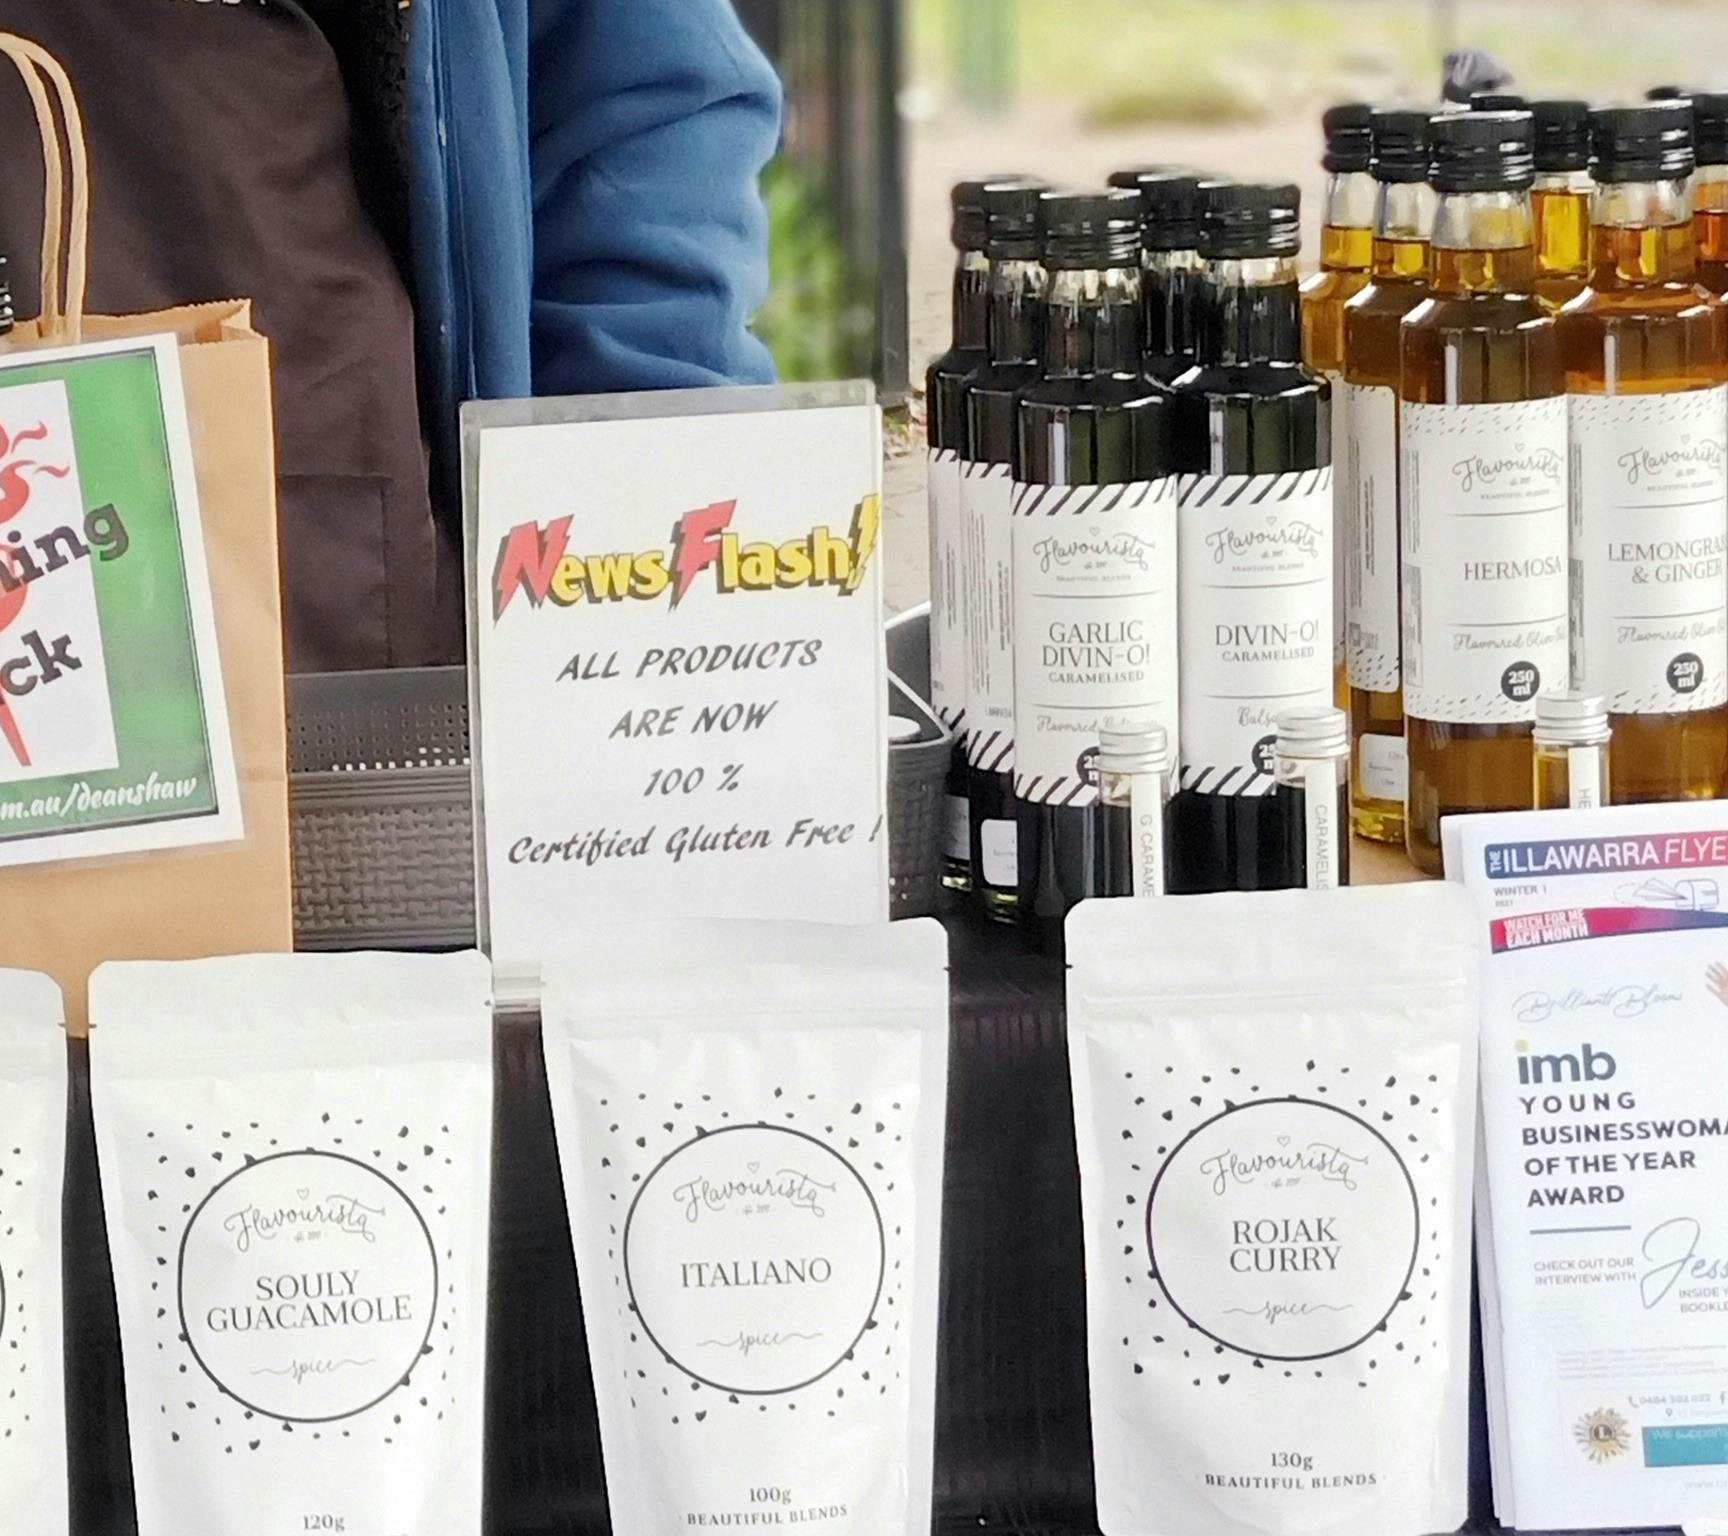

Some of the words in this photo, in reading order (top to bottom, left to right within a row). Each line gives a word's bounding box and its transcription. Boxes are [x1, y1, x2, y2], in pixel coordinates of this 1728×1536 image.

[1033, 530, 1156, 572] Flavourista
[1464, 556, 1562, 582] HERMOSA
[1631, 565, 1649, 585] &
[1655, 557, 1724, 584] GINGER
[1049, 620, 1144, 644] GARLIC
[1215, 619, 1320, 647] DIVIN-O!
[556, 651, 620, 683] ALL
[636, 639, 823, 679] PRODUCTS
[1042, 644, 1150, 668] DIVIN-O!
[1222, 646, 1315, 663] CARAMELISED
[1048, 670, 1145, 684] CARAMELISED
[1508, 669, 1535, 684] 250
[1673, 661, 1700, 677] 250
[1513, 682, 1532, 698] ml
[1677, 674, 1696, 690] ml
[608, 705, 683, 739] ARE
[690, 700, 781, 733] NOW
[642, 767, 705, 797] 100
[717, 763, 745, 794] %
[508, 825, 657, 867] Certified
[664, 821, 773, 862] Gluten
[785, 817, 855, 847] Free
[1489, 850, 1503, 872] THE
[1503, 840, 1660, 873] ILLAWARRA
[1494, 885, 1538, 897] WINTER
[1507, 930, 1541, 949] EACH
[1543, 924, 1589, 943] MONTH
[1516, 1039, 1617, 1085] imb
[1519, 1091, 1636, 1116] YOUNG
[1200, 1143, 1368, 1196] Flavourista
[1524, 1158, 1559, 1177] OF
[1566, 1154, 1618, 1174] THE
[1623, 1150, 1697, 1170] YEAR
[673, 1168, 836, 1224] Flavourista
[1527, 1184, 1625, 1208] AWARD
[224, 1194, 386, 1252] Flavourista
[1233, 1216, 1339, 1245] ROJAK
[1229, 1246, 1342, 1274] CURRY
[1534, 1259, 1575, 1272] CHECK
[1578, 1258, 1604, 1270] OUT
[1606, 1257, 1635, 1269] OUR
[255, 1270, 360, 1301] SOULY
[681, 1257, 832, 1289] ITALIANO
[1534, 1273, 1603, 1286] INTERVIEW
[1605, 1271, 1637, 1283] WITH
[1679, 1286, 1720, 1299] INSIDE
[207, 1295, 412, 1333] GUACAMOLE
[1271, 1452, 1313, 1470] 130g
[1205, 1474, 1306, 1490] BEAUTIFUL
[1311, 1472, 1377, 1489] BLENDS
[749, 1487, 791, 1505] 100g
[302, 1513, 346, 1532] 120g
[686, 1511, 784, 1526] BEAUTIFUL
[789, 1504, 848, 1523] BLENDS
